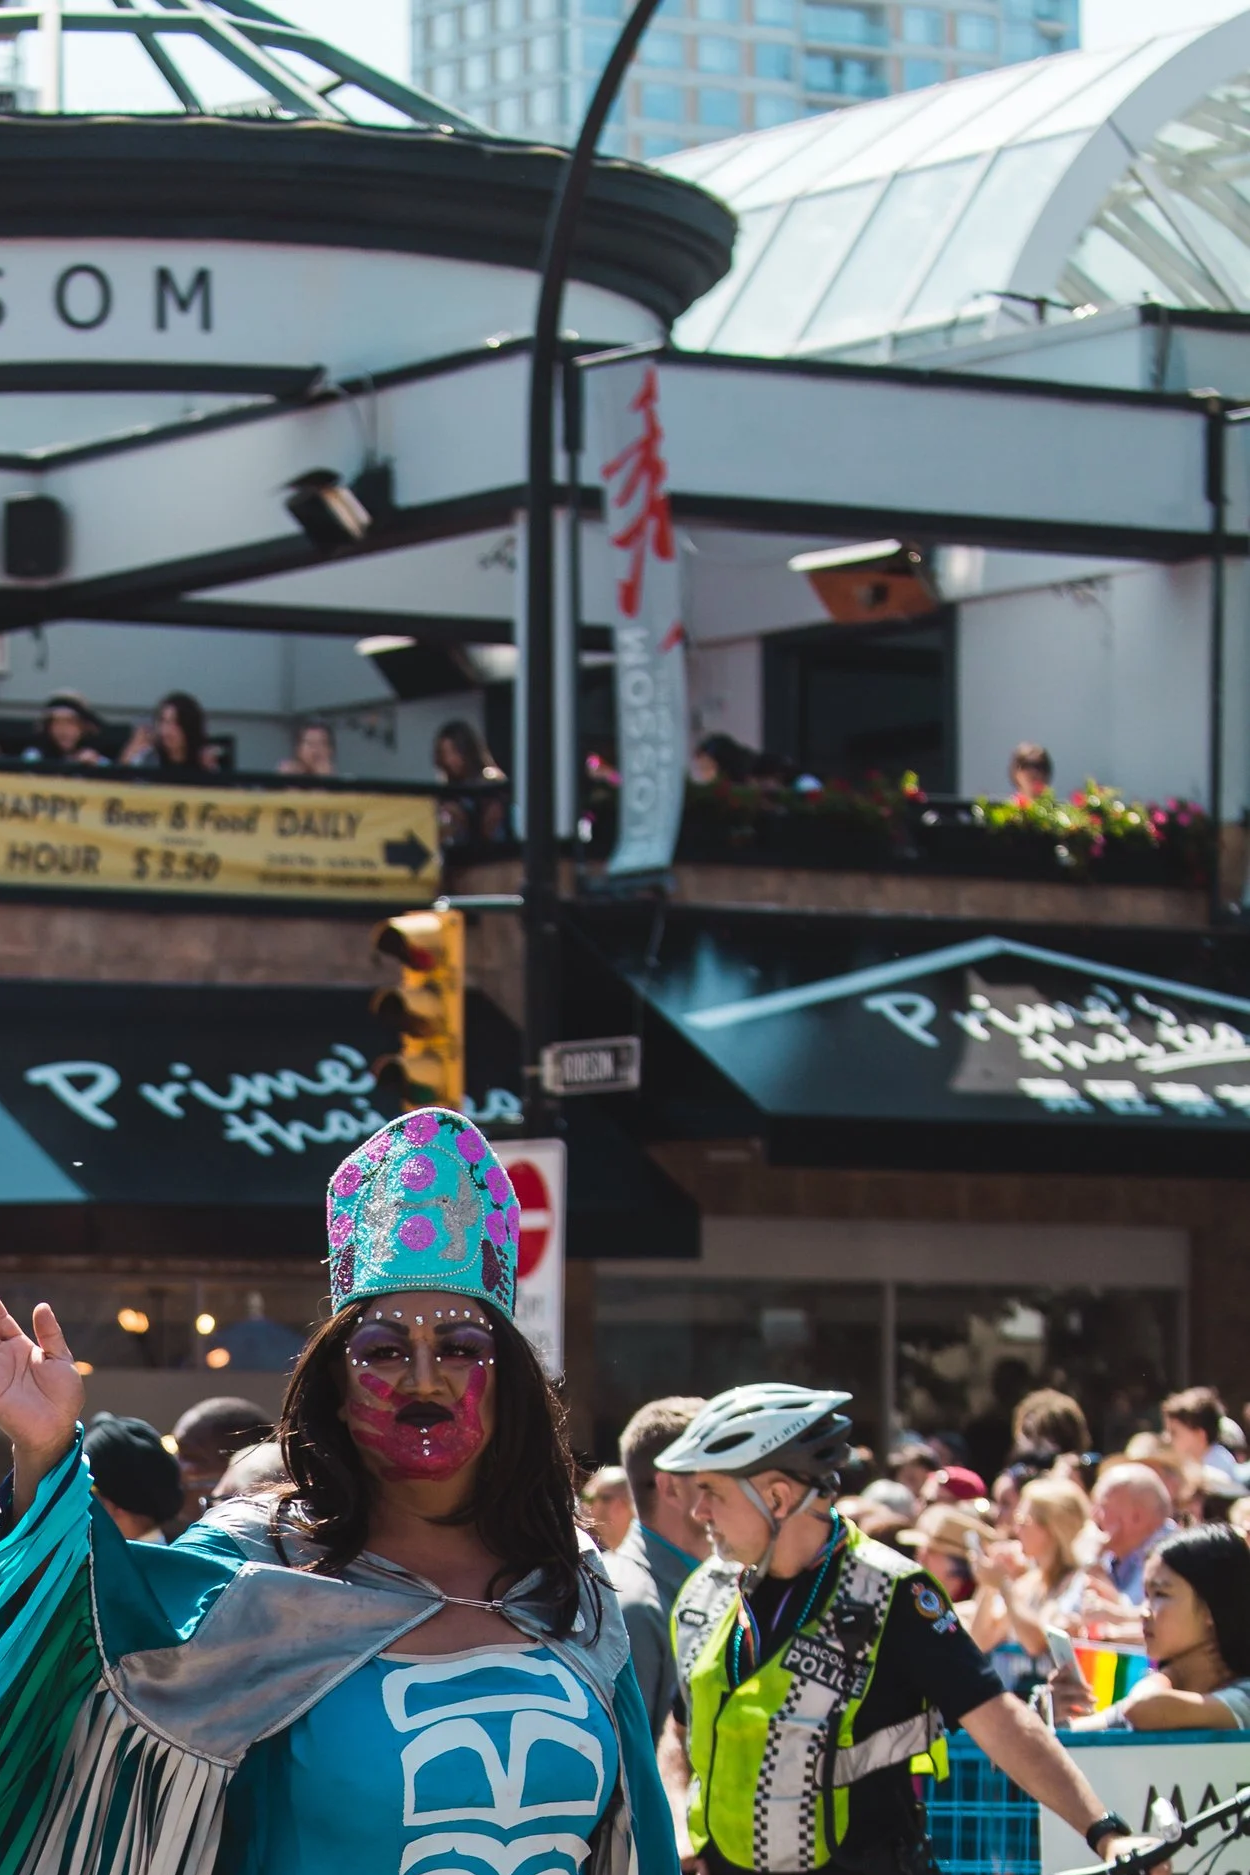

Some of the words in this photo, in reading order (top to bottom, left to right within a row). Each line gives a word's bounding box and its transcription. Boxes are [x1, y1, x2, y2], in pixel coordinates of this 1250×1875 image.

[104, 797, 160, 827] Beer
[169, 801, 189, 830] &
[197, 803, 262, 836] Food
[275, 807, 365, 841] DAILY
[6, 842, 102, 875] HOUR
[562, 1050, 615, 1083] ROBSON
[784, 1648, 866, 1696] POLICE
